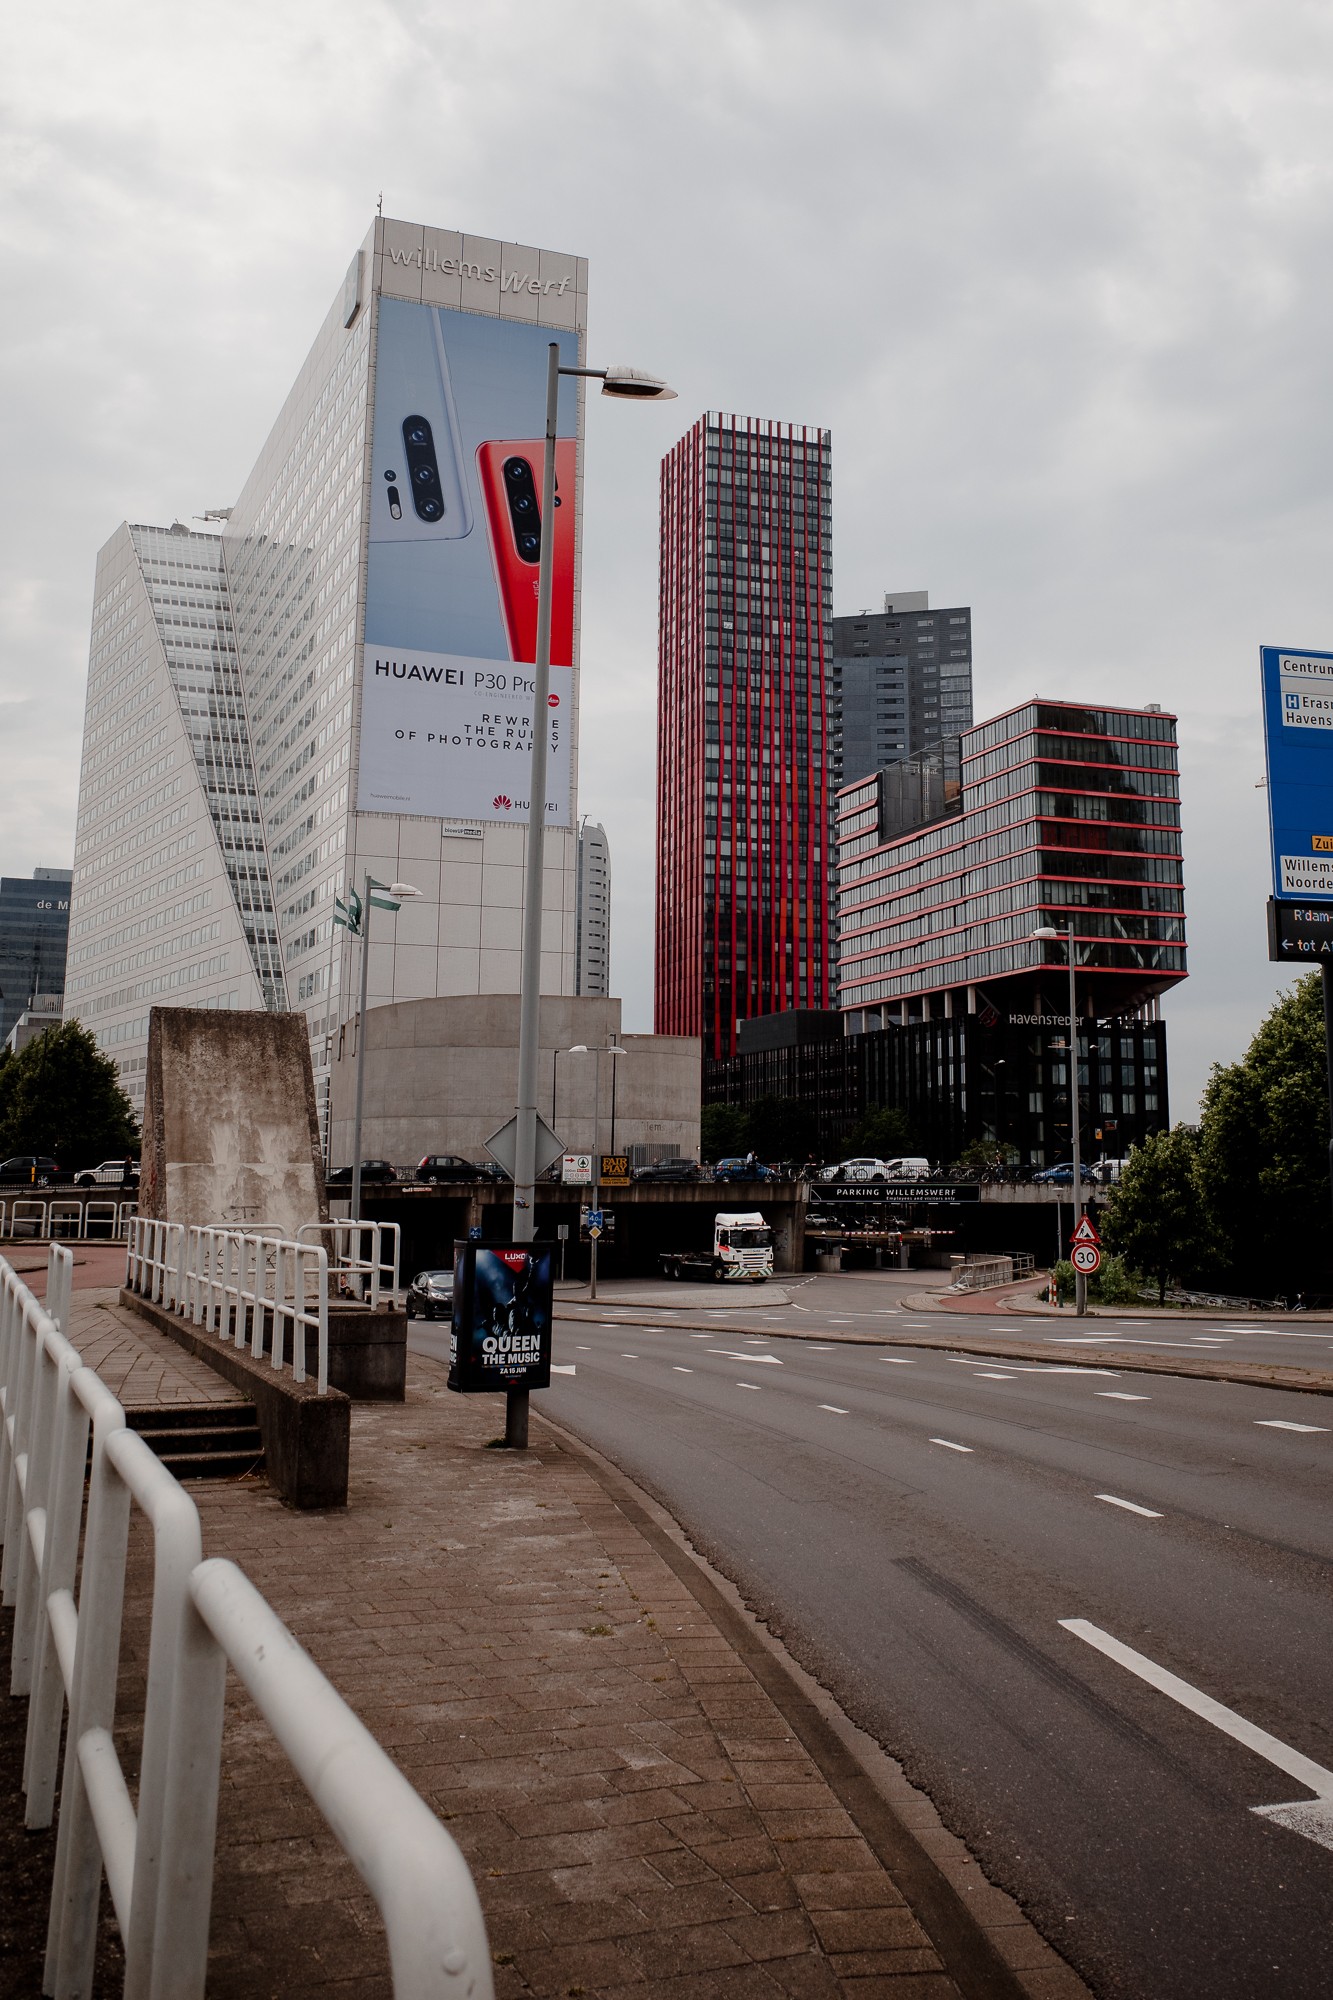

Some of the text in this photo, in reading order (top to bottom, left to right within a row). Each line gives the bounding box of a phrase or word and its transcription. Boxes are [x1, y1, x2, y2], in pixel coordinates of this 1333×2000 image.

[375, 659, 464, 686] HUAWEI
[474, 672, 506, 690] P30
[482, 714, 559, 729] REWRE
[464, 724, 559, 741] THE RUS
[395, 730, 559, 753] OF PHOTOGRAPY
[514, 800, 558, 812] HUEI
[37, 900, 52, 909] de
[1298, 940, 1316, 951] tot
[603, 1158, 627, 1166] FAIR
[603, 1164, 627, 1172] PLAY
[836, 1188, 956, 1197] PARKING WILLEMSWERF
[1077, 1252, 1095, 1263] 30
[482, 1335, 541, 1354] QUEEN
[481, 1353, 506, 1365] THE
[507, 1351, 540, 1364] MUSIC
[516, 1366, 527, 1374] JUN
